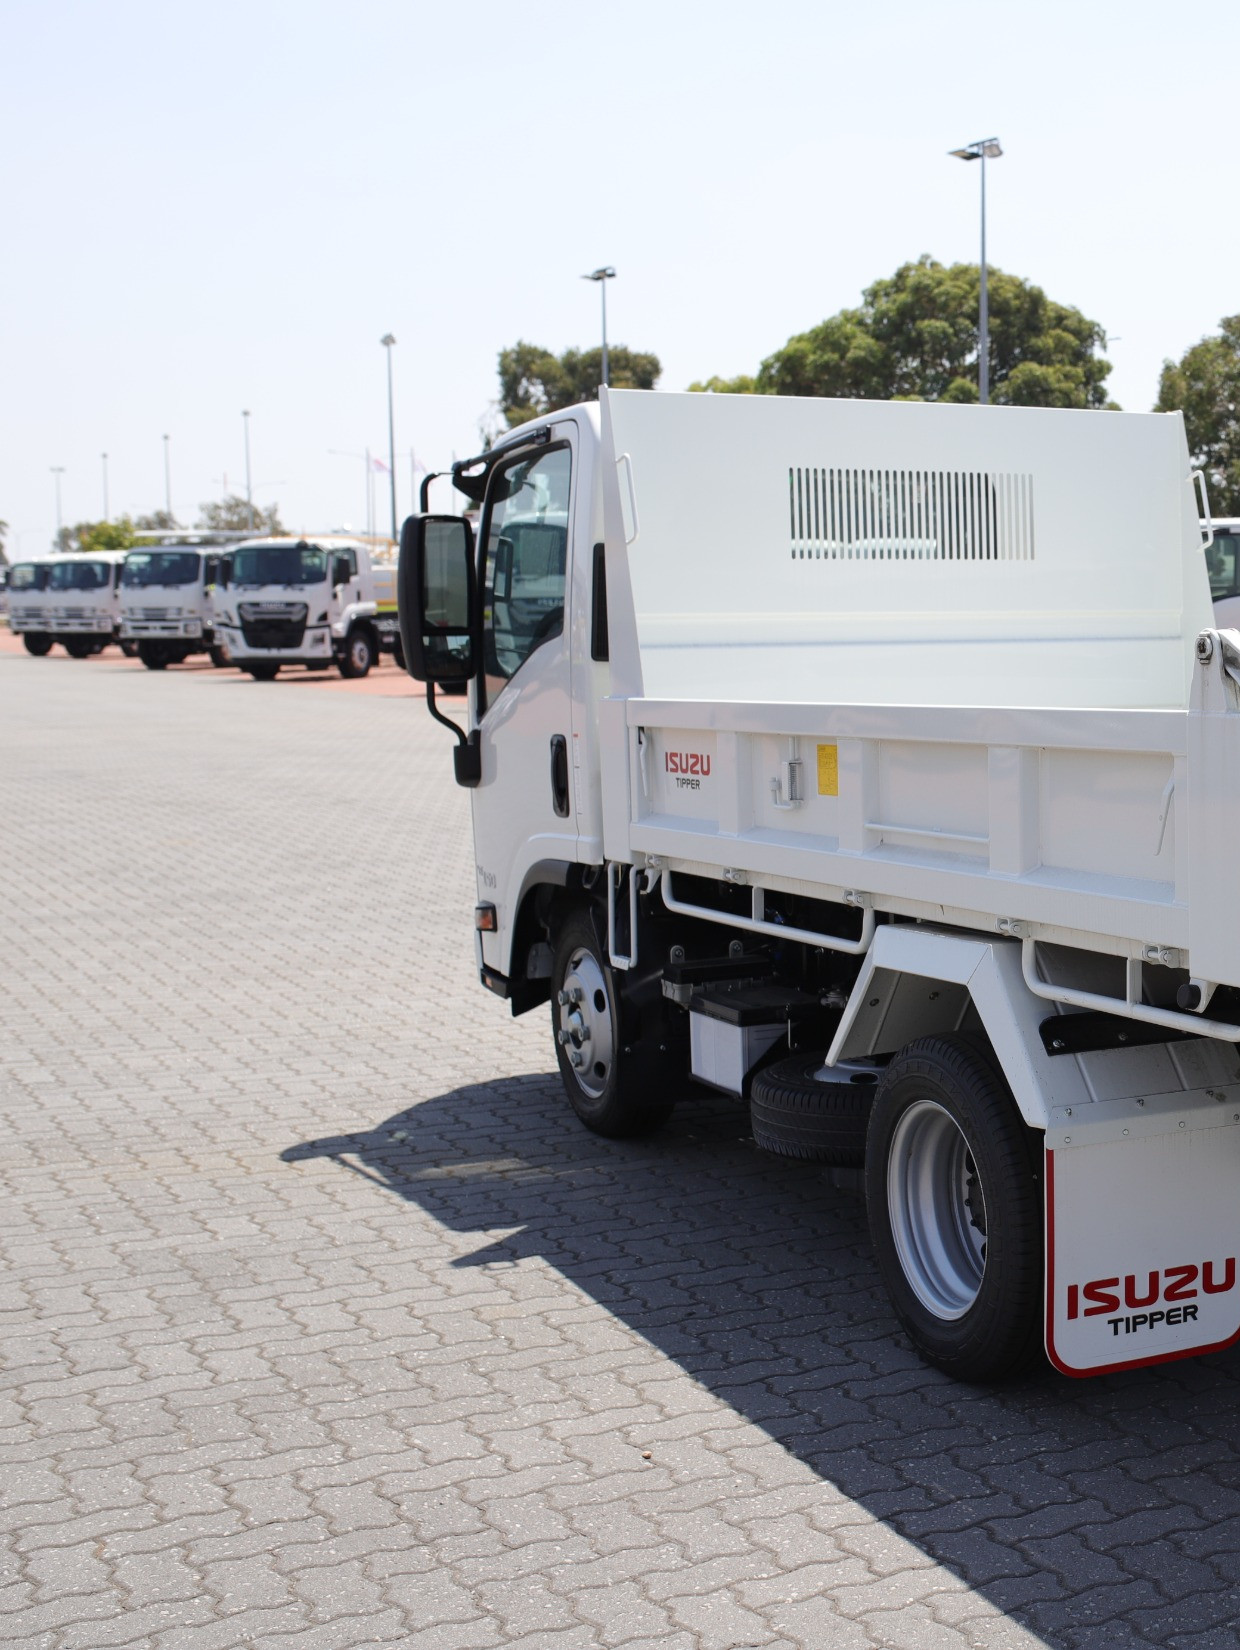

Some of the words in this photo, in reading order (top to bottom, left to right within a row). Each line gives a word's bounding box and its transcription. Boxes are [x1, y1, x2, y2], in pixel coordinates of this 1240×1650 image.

[665, 751, 711, 776] ISUZU
[675, 777, 701, 790] TIPPER
[1067, 1257, 1236, 1320] ISUZU
[1107, 1304, 1199, 1336] TIPPER
